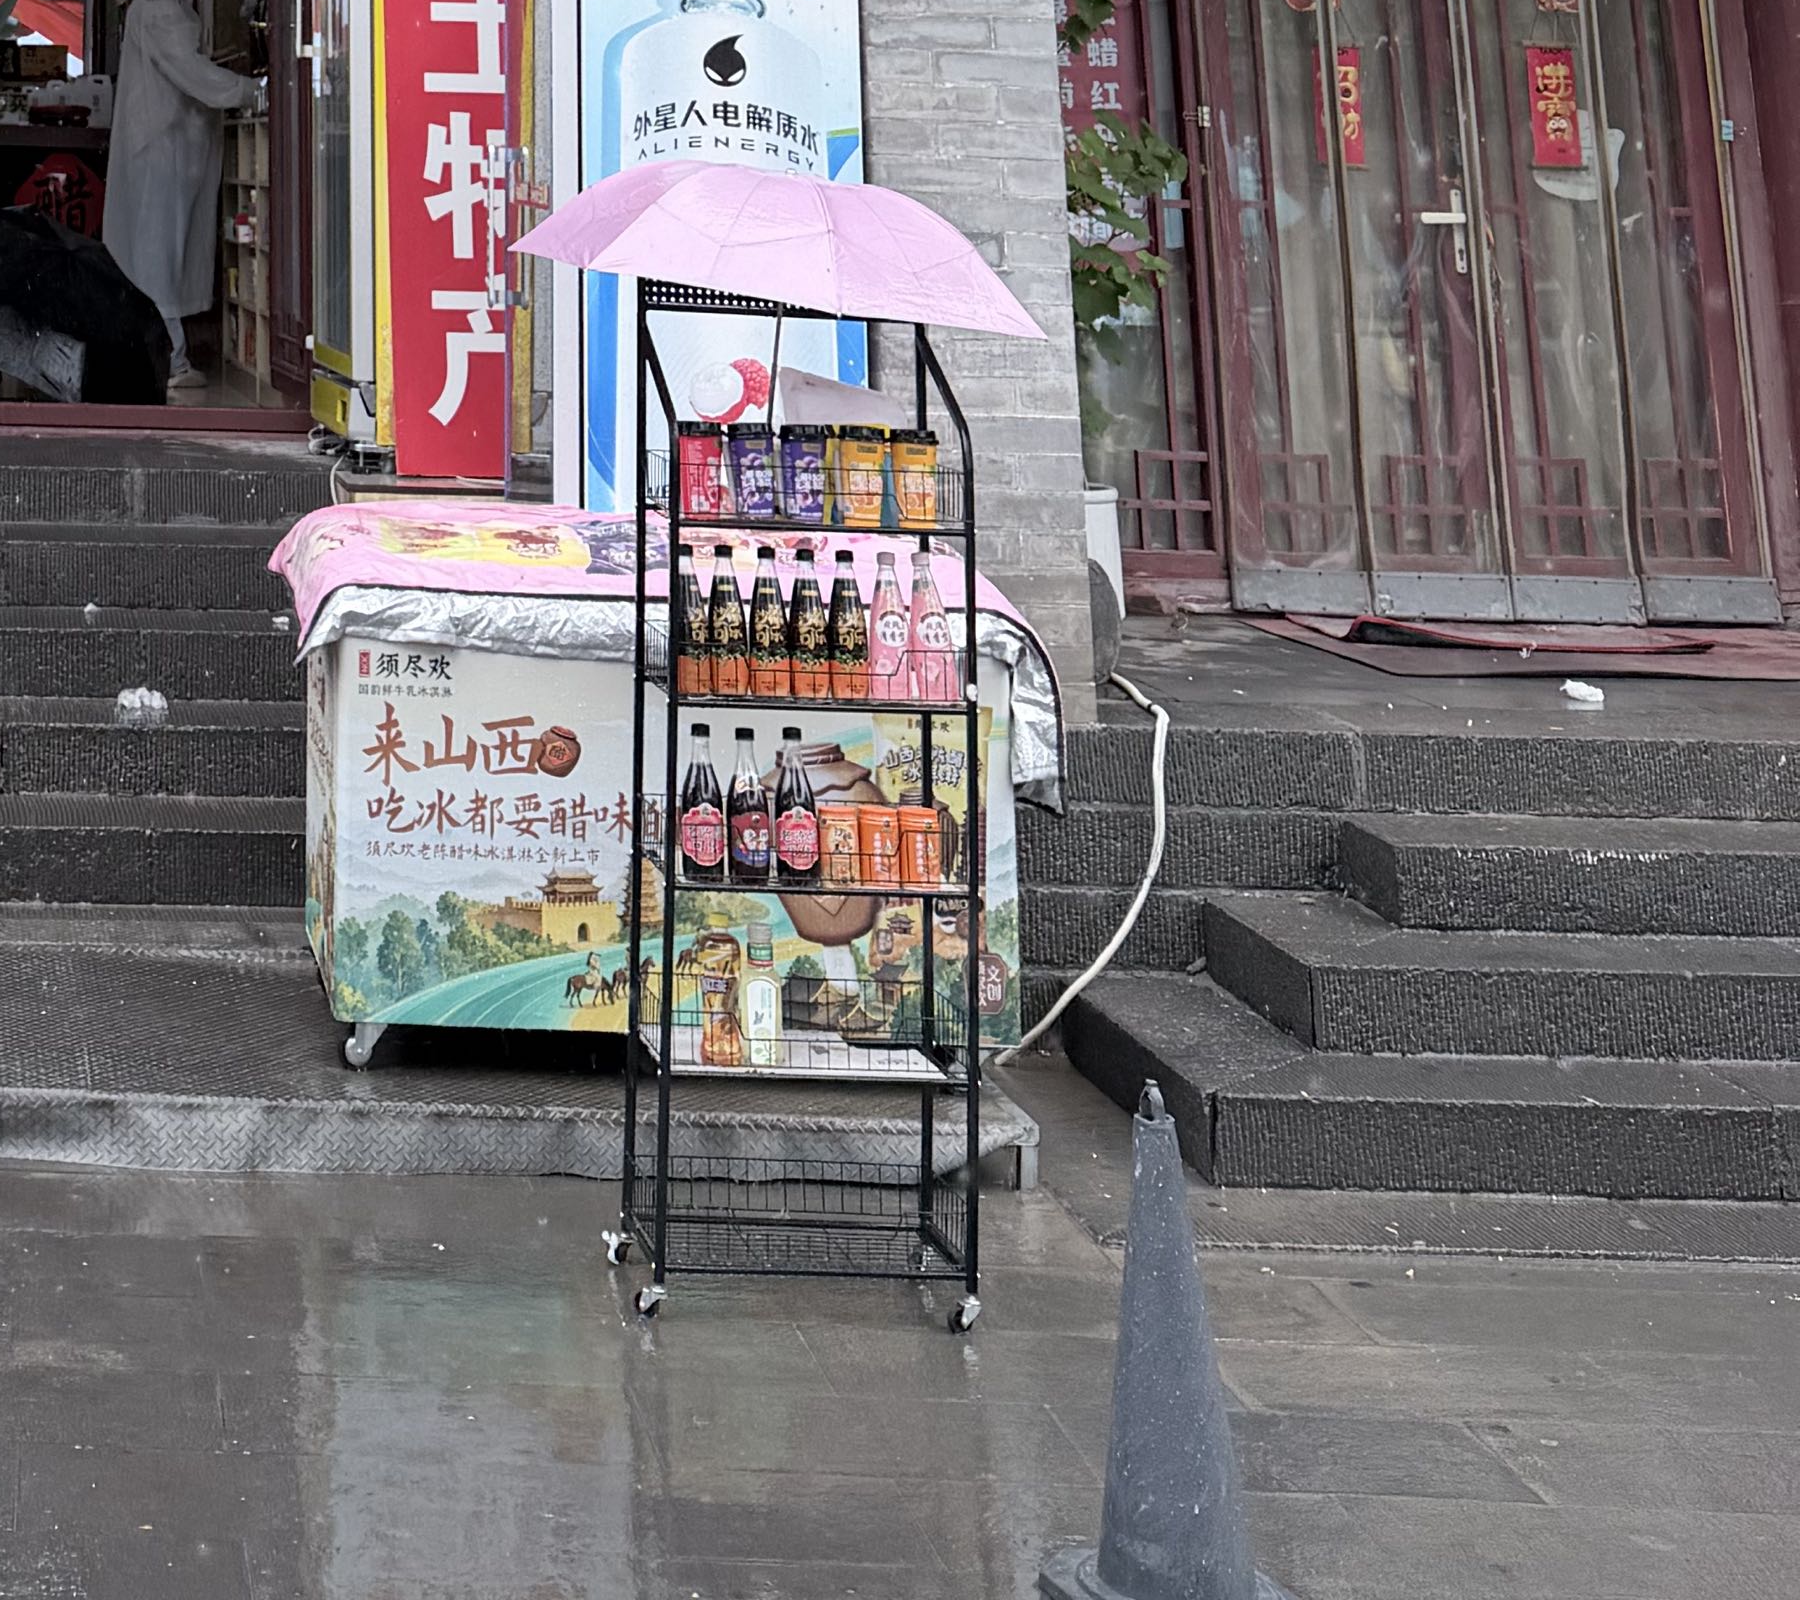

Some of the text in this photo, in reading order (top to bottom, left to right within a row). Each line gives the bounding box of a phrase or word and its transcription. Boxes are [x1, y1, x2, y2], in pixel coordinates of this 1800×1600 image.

[633, 99, 820, 157] 外星人电解质水
[637, 135, 814, 171] ALIENERGY
[375, 652, 453, 681] 须尽欢
[361, 701, 541, 787] 来山西
[366, 840, 601, 867] 须尽欢老陈醋味冰淇淋全新上市
